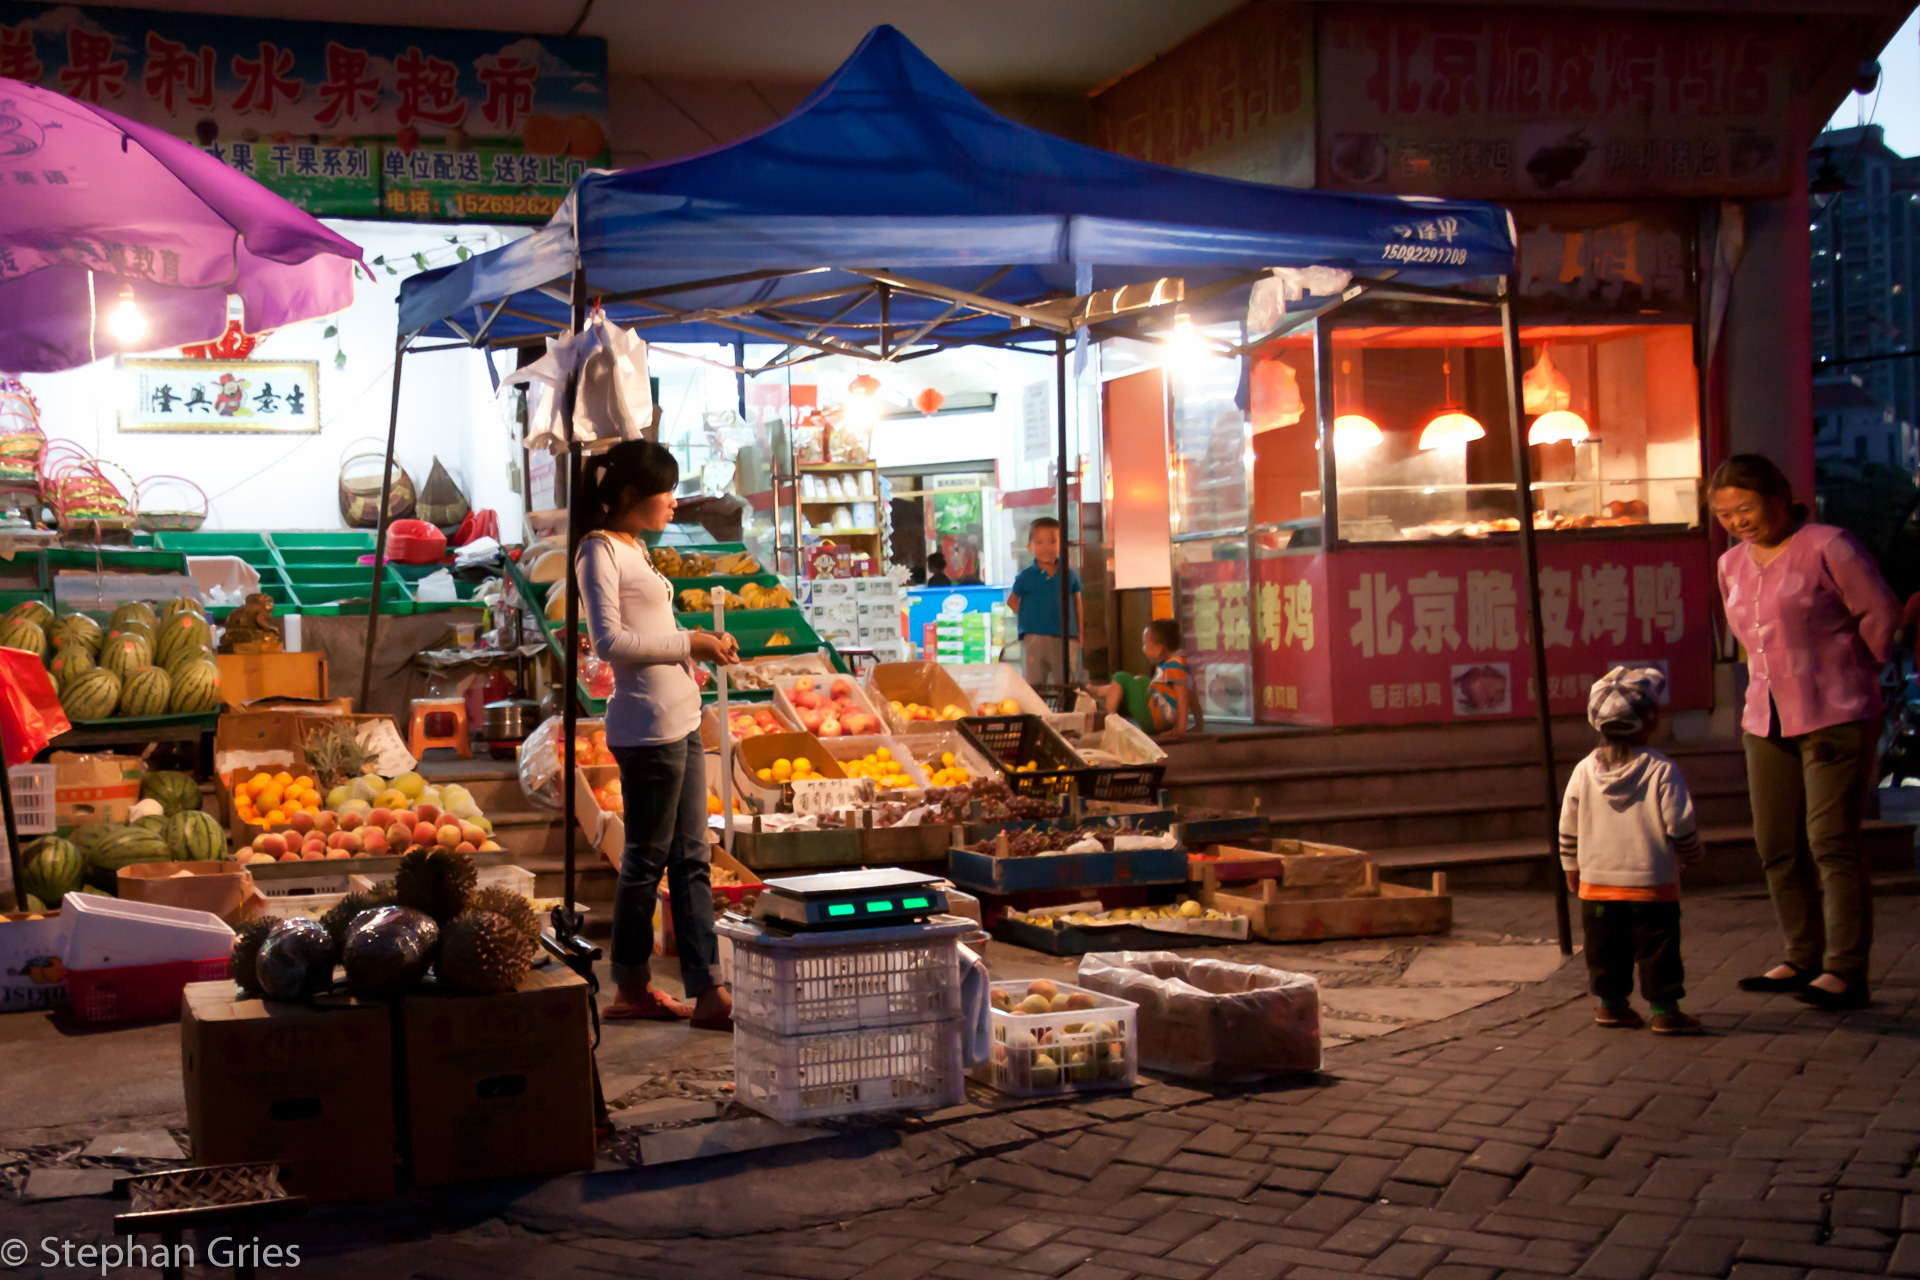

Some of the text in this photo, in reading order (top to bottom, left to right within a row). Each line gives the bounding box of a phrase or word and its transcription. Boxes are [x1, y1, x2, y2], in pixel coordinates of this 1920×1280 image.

[270, 145, 369, 178] 干果系列
[384, 151, 480, 182] 单位配送
[495, 155, 586, 185] 送货上门
[1381, 244, 1468, 266] 15092291708
[1193, 579, 1315, 652] 香菇烤鸡
[1348, 561, 1685, 658] 北京脆皮烤鸭
